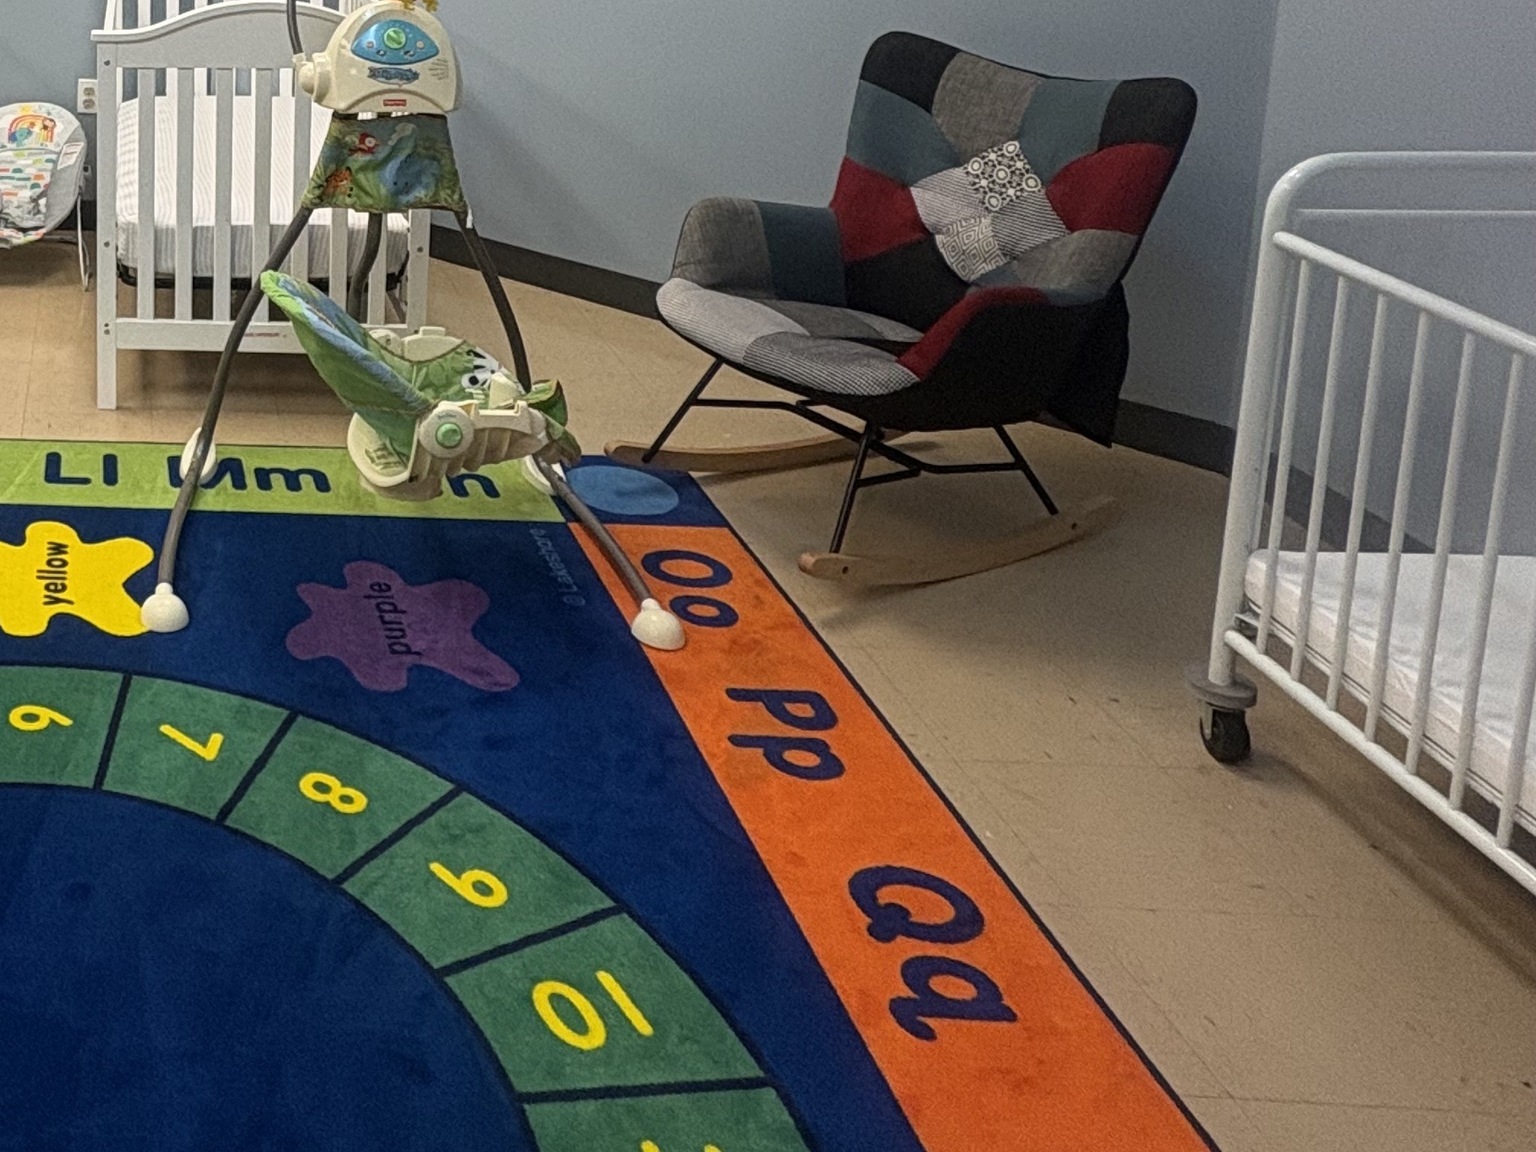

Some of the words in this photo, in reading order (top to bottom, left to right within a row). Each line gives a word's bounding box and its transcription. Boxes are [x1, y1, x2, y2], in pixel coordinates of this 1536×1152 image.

[44, 451, 119, 487] Ll
[167, 455, 331, 493] Mm
[445, 472, 501, 498] n
[42, 541, 75, 605] yellow
[529, 527, 578, 593] Lakeshore
[641, 549, 739, 627] Oo
[363, 581, 423, 655] purple
[8, 704, 74, 732] 6
[159, 723, 224, 762] 7
[724, 687, 847, 781] Pp
[298, 771, 368, 815] 8
[429, 861, 509, 908] 9
[848, 864, 1019, 1042] Qq
[531, 969, 654, 1051] 10
